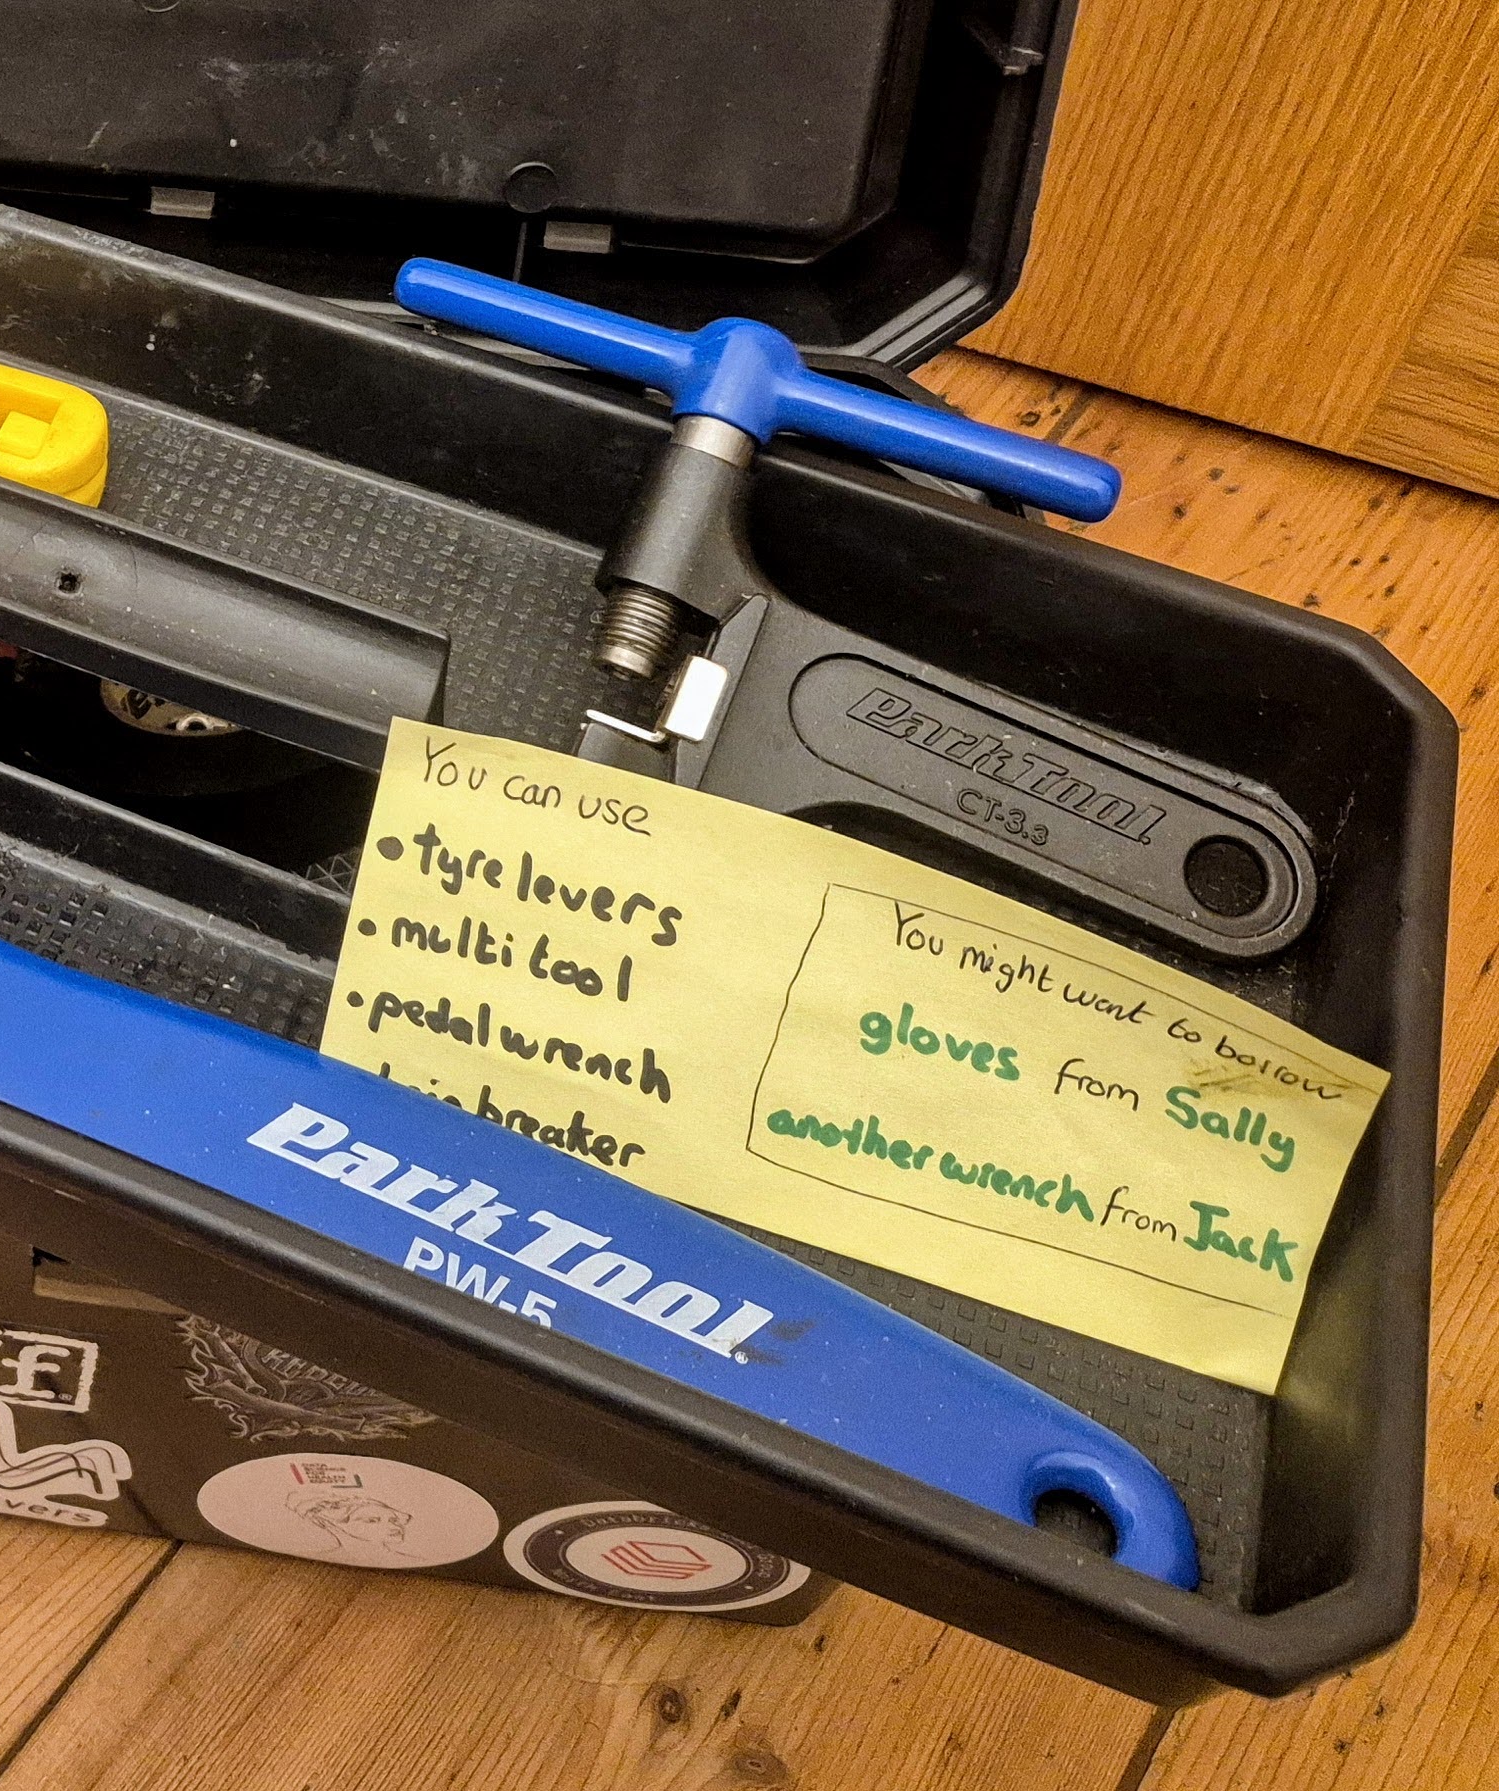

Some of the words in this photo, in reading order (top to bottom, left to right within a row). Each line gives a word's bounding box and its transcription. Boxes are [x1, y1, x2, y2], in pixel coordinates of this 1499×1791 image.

[425, 736, 487, 787] You
[503, 774, 561, 810] can
[578, 795, 651, 837] use
[955, 787, 1050, 847] CT-3.3
[413, 822, 502, 895] tyre
[517, 851, 683, 947] levers
[391, 917, 514, 968] multi
[529, 933, 632, 1002] tool
[895, 901, 943, 956] You
[959, 942, 1054, 993] might
[1063, 981, 1155, 1024] want
[1166, 1014, 1201, 1044] to
[1216, 1033, 1343, 1100] borrow
[367, 991, 491, 1047] pedal
[500, 1026, 671, 1104] wrench
[859, 1002, 1020, 1080] gloves
[1054, 1057, 1140, 1111] from
[1165, 1085, 1295, 1173] Sally
[477, 1085, 646, 1168] breaker
[766, 1107, 933, 1171] another
[939, 1153, 1095, 1223] wrench
[1101, 1187, 1178, 1245] from
[1184, 1200, 1301, 1283] Jack
[401, 1235, 558, 1331] PW-5
